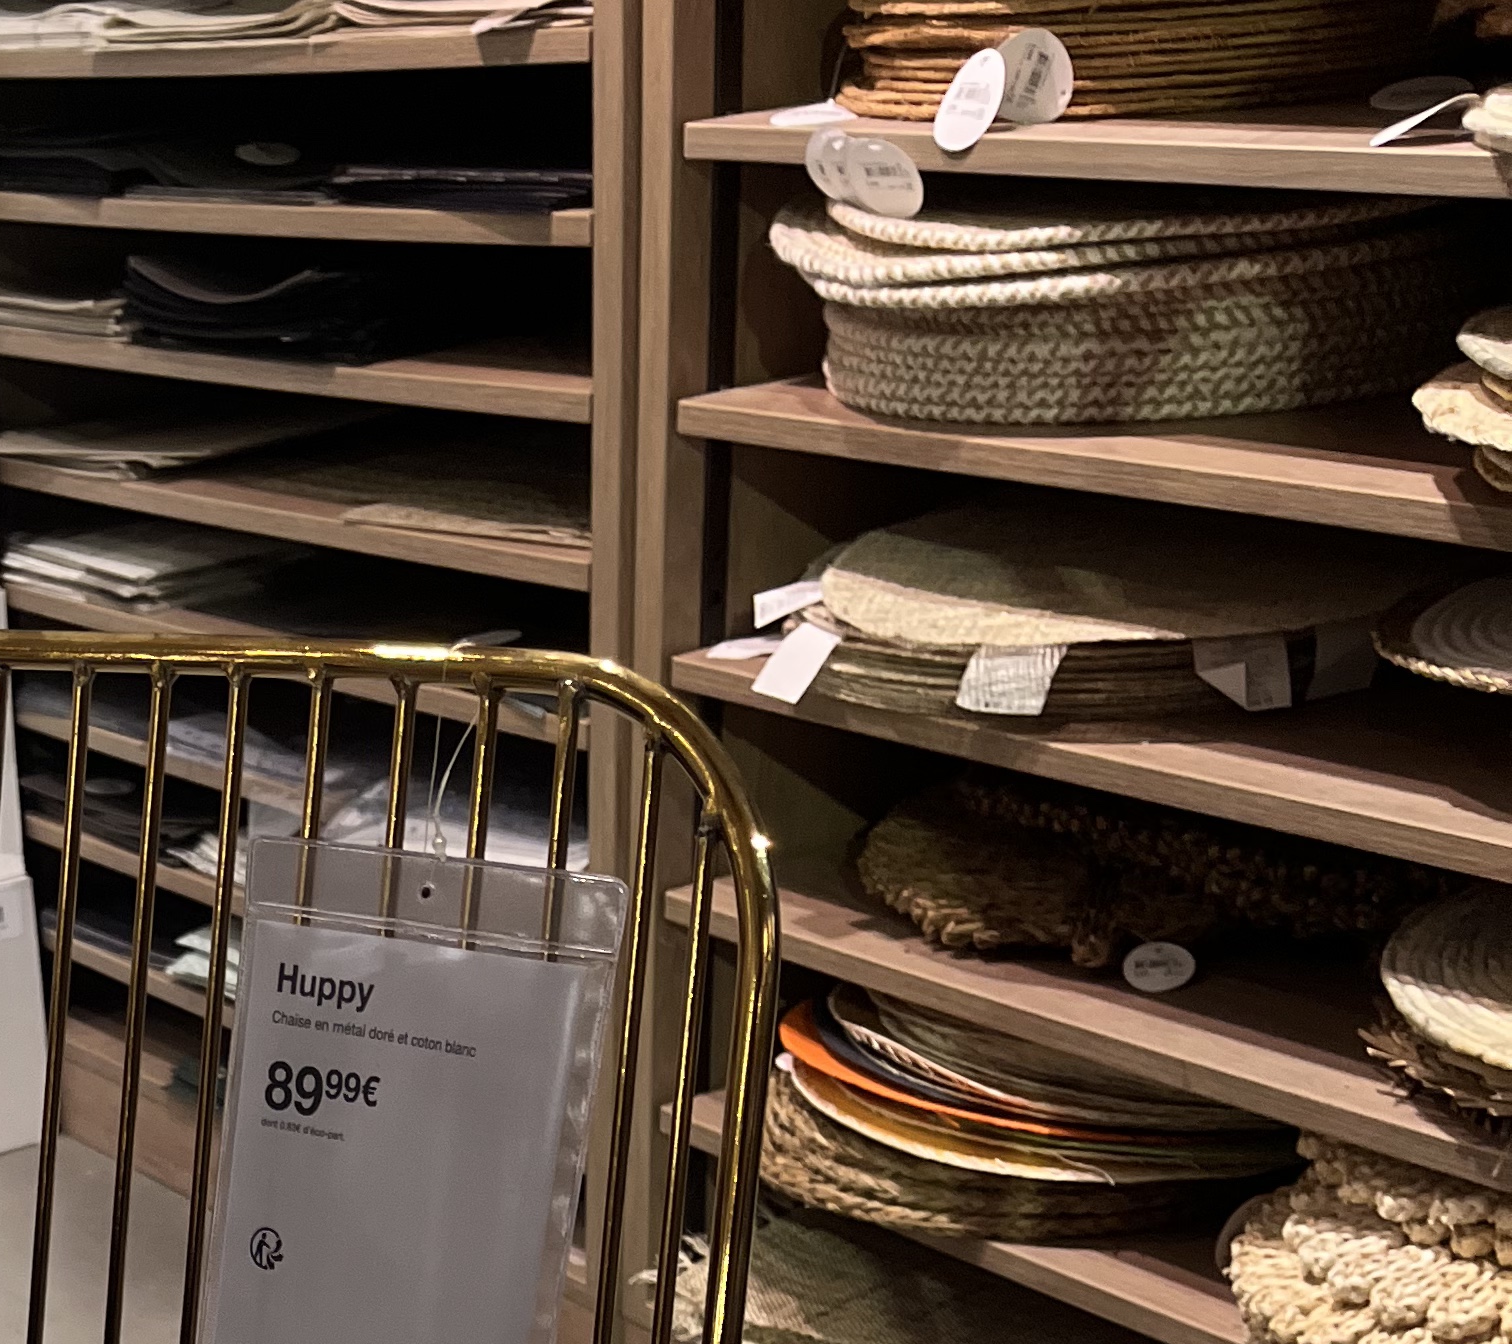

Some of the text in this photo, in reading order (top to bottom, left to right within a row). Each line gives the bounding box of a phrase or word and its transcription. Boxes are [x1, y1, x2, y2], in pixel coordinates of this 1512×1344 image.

[277, 962, 374, 1012] Huppy
[272, 1010, 477, 1058] Chaise en métal doré et coton blanc
